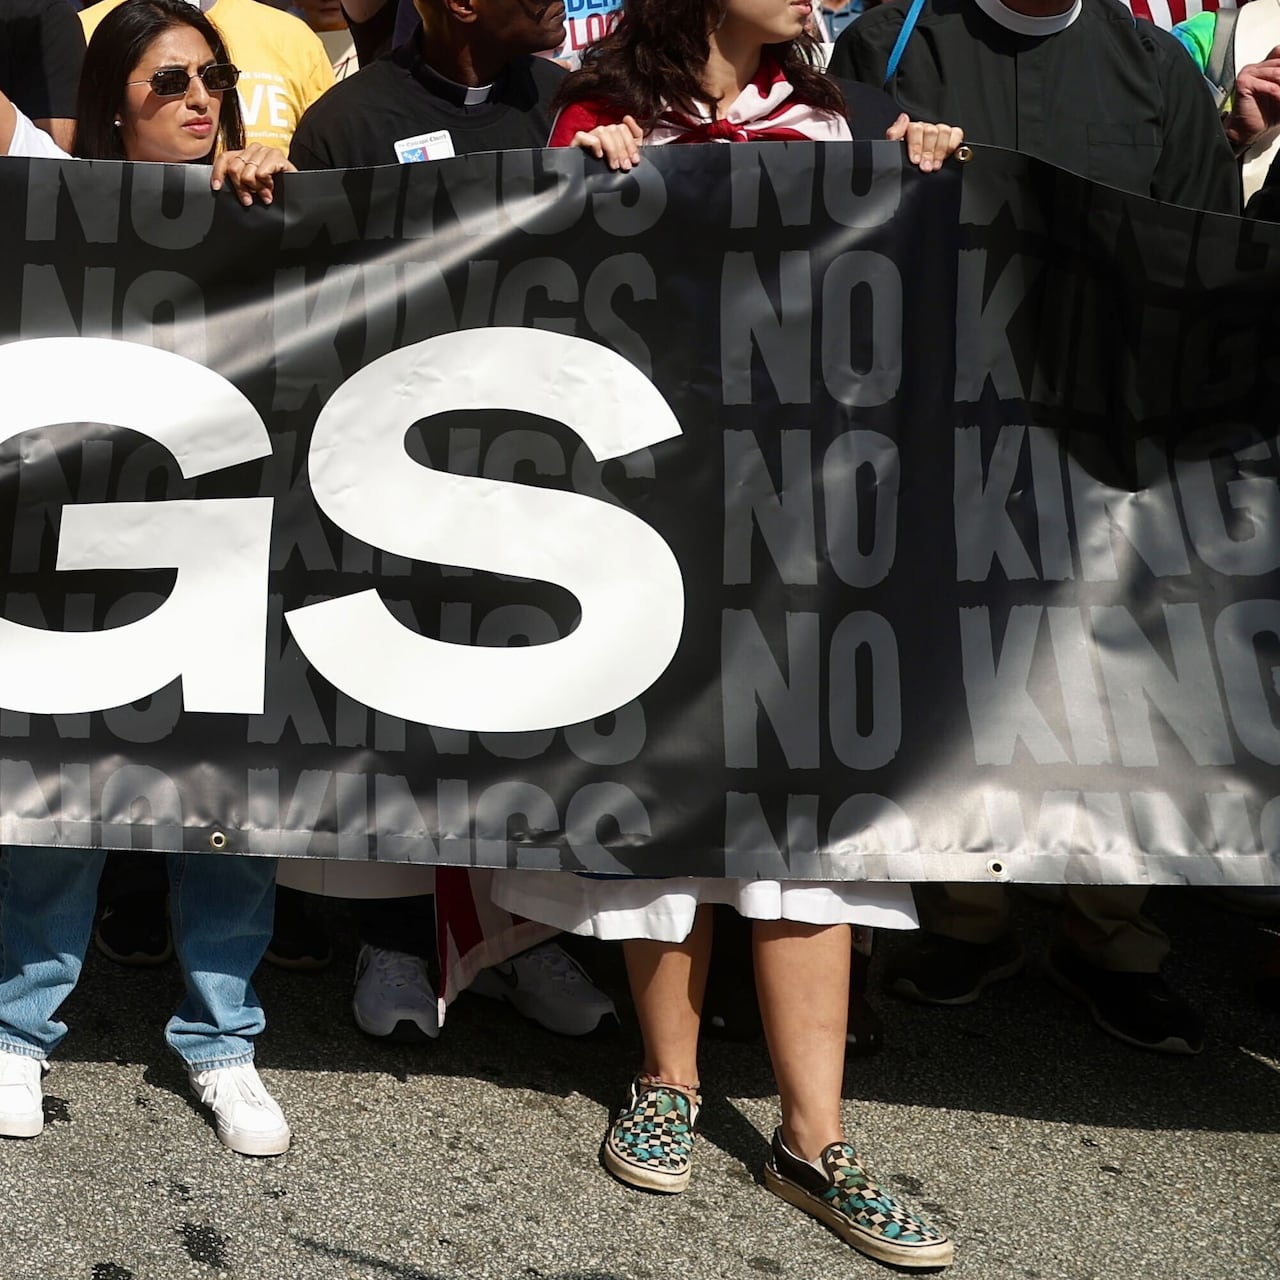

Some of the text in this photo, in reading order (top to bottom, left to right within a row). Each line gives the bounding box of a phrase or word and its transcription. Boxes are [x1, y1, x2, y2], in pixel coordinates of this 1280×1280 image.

[721, 249, 903, 409] NO
[722, 428, 900, 588] NO
[721, 606, 903, 772] NO
